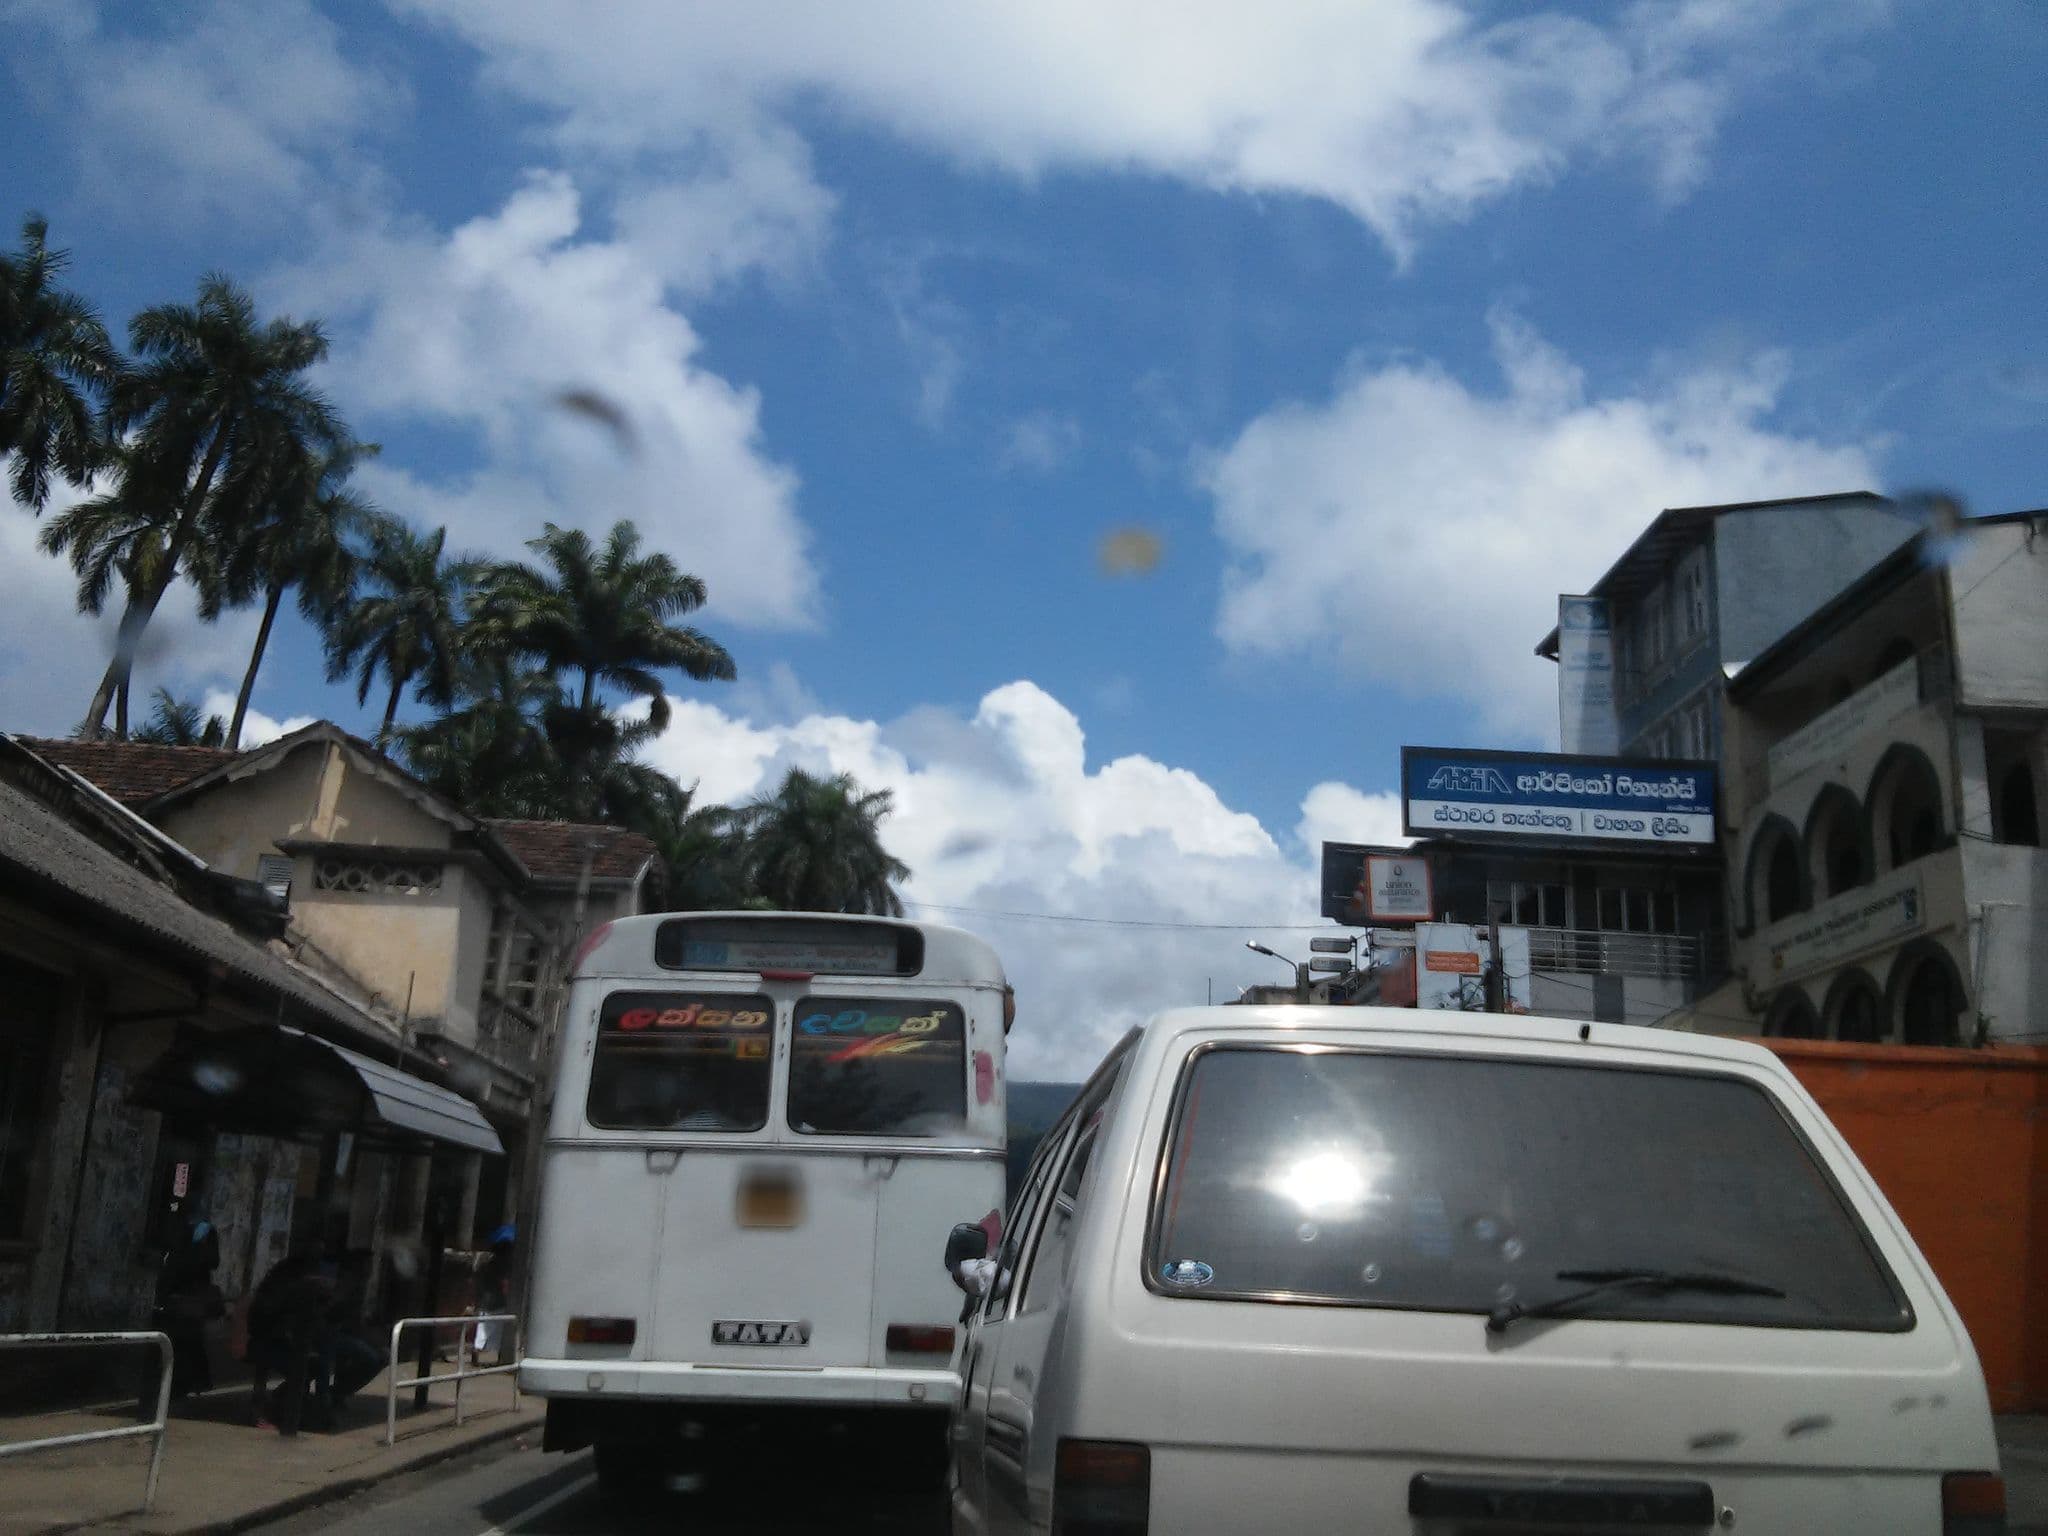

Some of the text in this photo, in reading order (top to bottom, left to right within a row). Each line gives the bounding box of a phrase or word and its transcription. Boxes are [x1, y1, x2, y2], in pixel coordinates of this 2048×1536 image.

[1433, 804, 1496, 825] ස්ථාවර
[1594, 814, 1645, 833] වාහන
[719, 1323, 804, 1344] TATA
